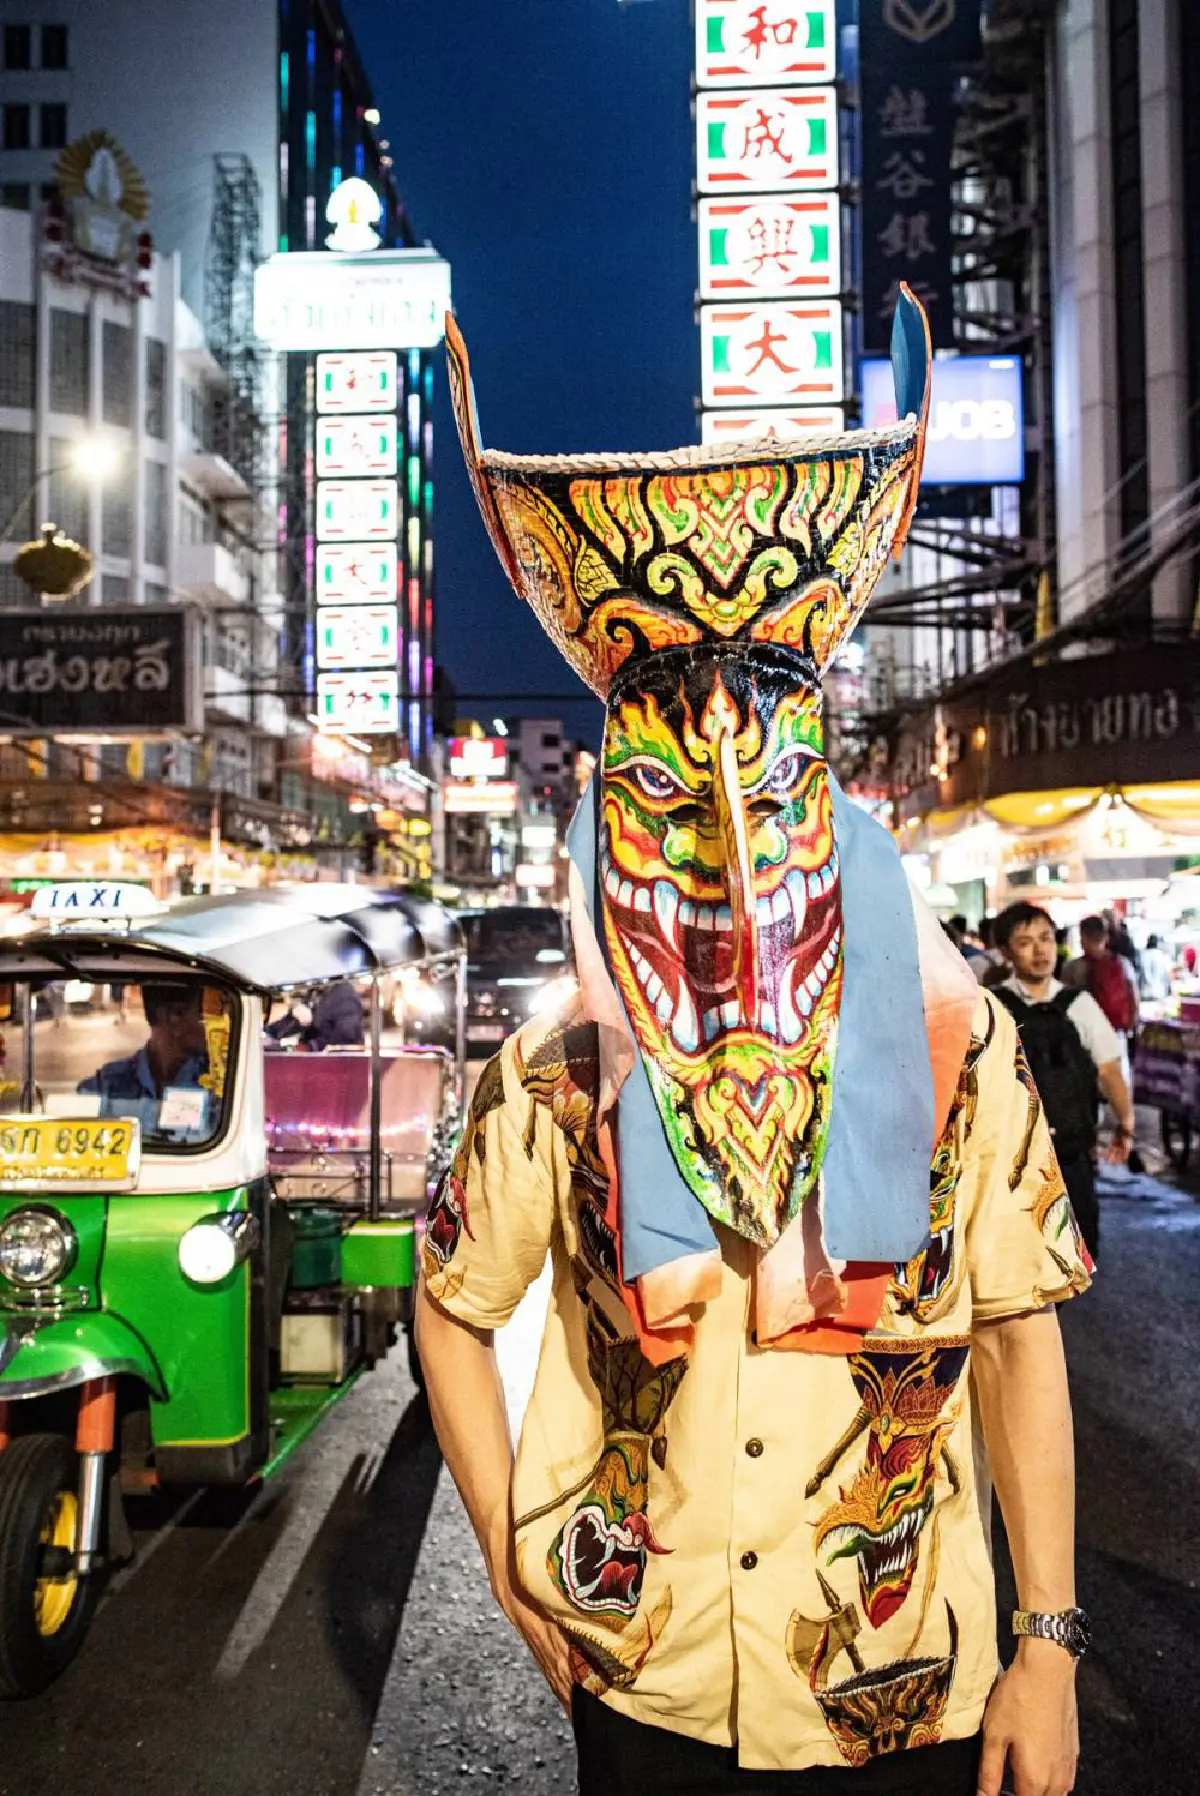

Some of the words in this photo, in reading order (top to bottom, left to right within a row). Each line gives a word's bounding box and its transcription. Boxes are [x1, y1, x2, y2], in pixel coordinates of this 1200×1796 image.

[740, 6, 800, 437] 和成興大
[0, 639, 170, 692] เฮงหลี
[50, 888, 121, 907] TAXI
[55, 1126, 126, 1155] 6942
